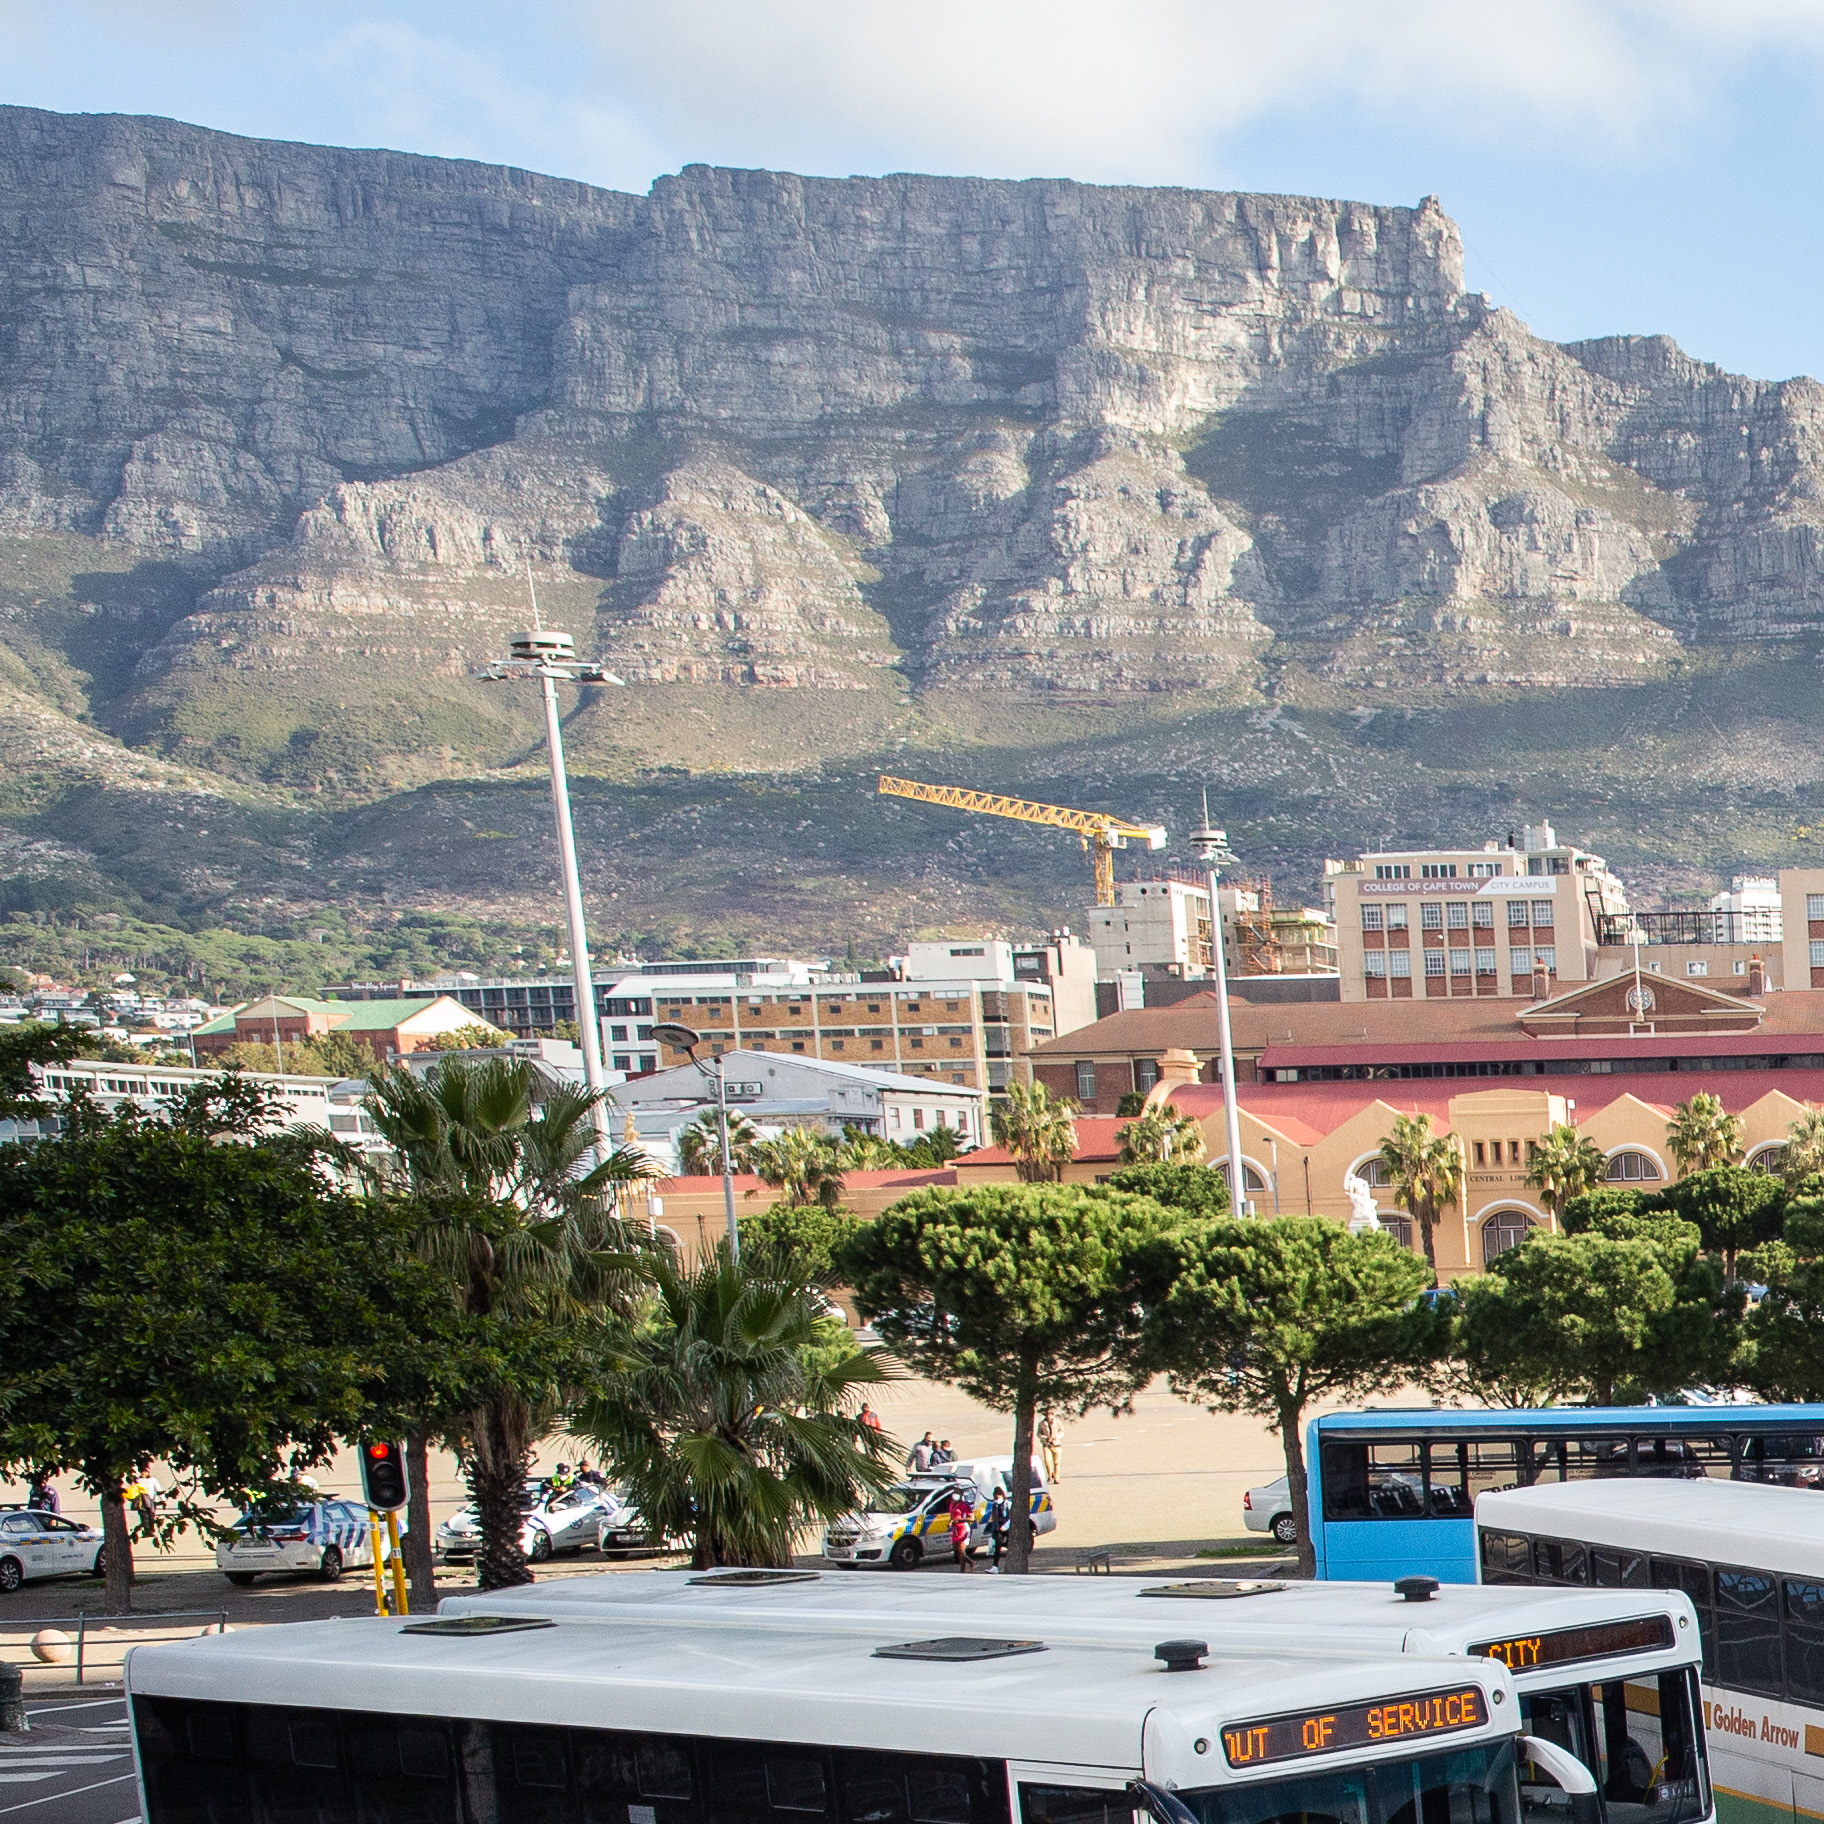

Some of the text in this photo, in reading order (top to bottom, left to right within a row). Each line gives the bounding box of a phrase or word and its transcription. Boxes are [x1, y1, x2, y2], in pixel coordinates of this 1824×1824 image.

[1364, 882, 1479, 892] COLLEGE OF CAPE TOWN
[1490, 881, 1550, 890] CITY CAMPUS
[1470, 1175, 1504, 1183] CENTRAL
[1488, 1637, 1541, 1669] CITY
[1302, 1716, 1336, 1750] OF
[1367, 1692, 1478, 1740] SERVICE
[1713, 1703, 1800, 1749] Golden Arrow
